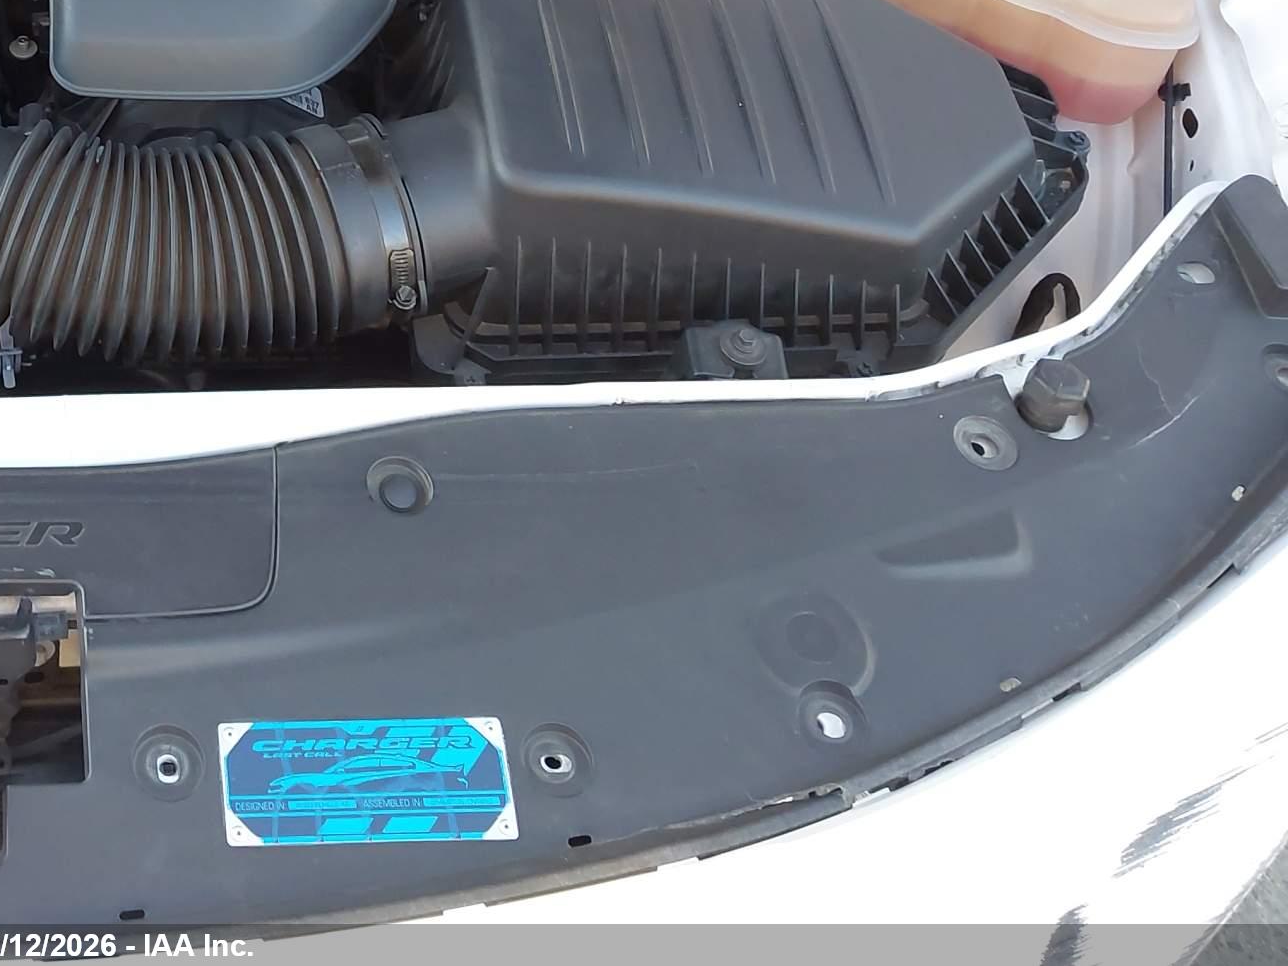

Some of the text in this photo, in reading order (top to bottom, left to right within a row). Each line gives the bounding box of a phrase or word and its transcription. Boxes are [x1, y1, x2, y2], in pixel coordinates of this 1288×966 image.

[252, 735, 477, 752] CHARGER
[304, 750, 344, 758] CALL
[235, 801, 276, 811] DESIGNED
[363, 798, 410, 808] ASSEMBLED
